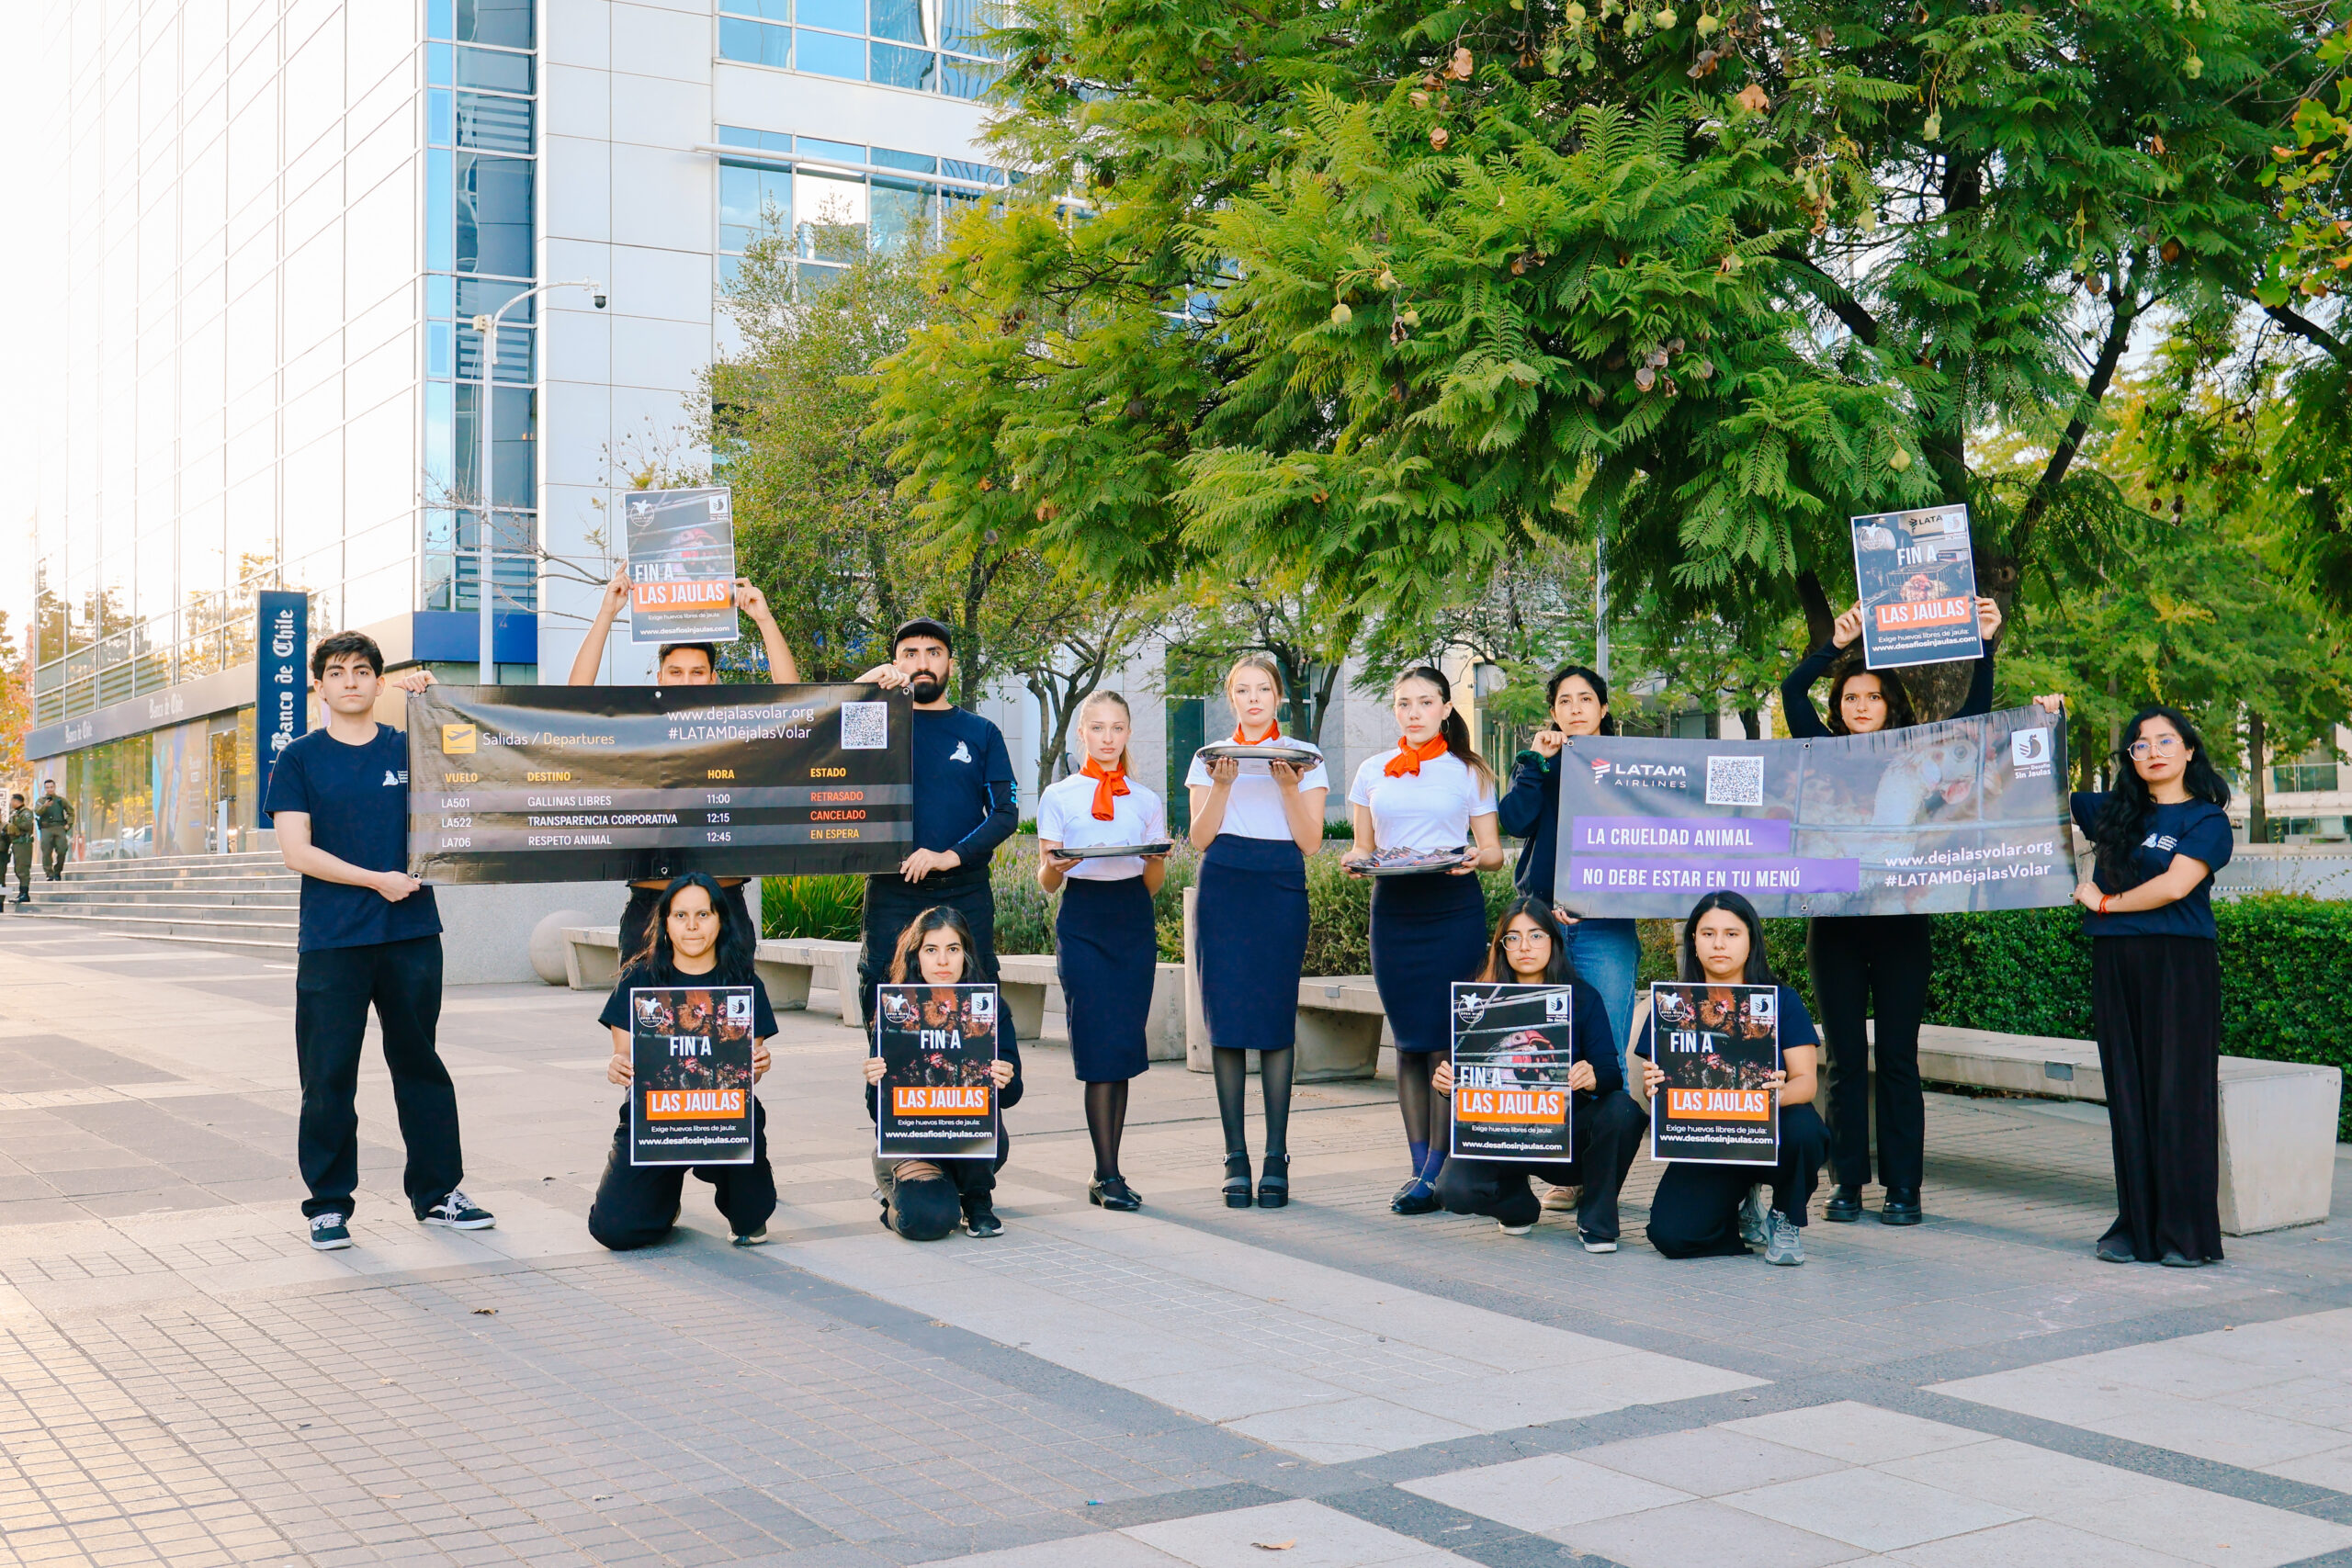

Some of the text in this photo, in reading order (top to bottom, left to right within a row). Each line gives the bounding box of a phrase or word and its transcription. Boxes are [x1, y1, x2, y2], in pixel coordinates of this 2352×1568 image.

[1896, 545, 1938, 566] FIN A
[635, 563, 673, 582] FIN A
[639, 583, 725, 604] LAS JAULAS
[1882, 599, 1965, 624] LAS JAULAS
[1872, 636, 1977, 652] www.desafiosinjaulas.com
[1878, 635, 1896, 643] Exige
[1897, 633, 1922, 641] huevos
[1951, 628, 1969, 637] jaula:
[271, 609, 296, 751] Banco de Chile
[667, 705, 815, 723] www.dejalasvolar.org
[482, 732, 616, 748] Salidas / Departures
[668, 725, 812, 742] #LATAMDéjalasVolar
[445, 768, 846, 783] VUELO DESTINO HORA ESTADO
[1615, 763, 1686, 776] LATAM
[2029, 769, 2051, 777] Jaulas
[1615, 779, 1687, 788] AIRLINES
[441, 791, 864, 808] LA501 GALLINAS LIBRES 11:00 RETRASADO
[441, 810, 866, 828] LA522 TRANSPARENCIA CORPORATIVA 12:15 CANCELADO
[441, 829, 860, 848] LA706 RESPETO ANIMAL 12:45 EN ESPERA
[1588, 828, 1754, 846] LA CRUELDAD ANIMAL
[1885, 841, 2053, 867] www.dejalasvolar.org
[1583, 867, 1800, 887] NO DEBE ESTAR EN TU MENÚ
[1884, 863, 2051, 887] #LATAMDéjalasVolar
[670, 1036, 712, 1056] FIN A
[921, 1030, 961, 1049] FIN A
[1670, 1032, 1713, 1054] FIN A
[1460, 1066, 1502, 1089] FIN A
[651, 1092, 741, 1112] LAS JAULAS
[899, 1089, 984, 1108] LAS JAULAS
[1463, 1092, 1559, 1115] LAS JAULAS
[1673, 1091, 1764, 1112] LAS JAULAS
[718, 1124, 736, 1133] jaula:
[885, 1130, 992, 1139] www.desafiosinjaulas.com
[1666, 1124, 1686, 1133] Exige
[1747, 1126, 1767, 1135] jaula:
[639, 1136, 749, 1145] www.desafiosinjaulas.com
[1462, 1141, 1562, 1151] www.desafiosinjaulas.com
[1659, 1134, 1773, 1145] www.desafiosinjaulas.com
